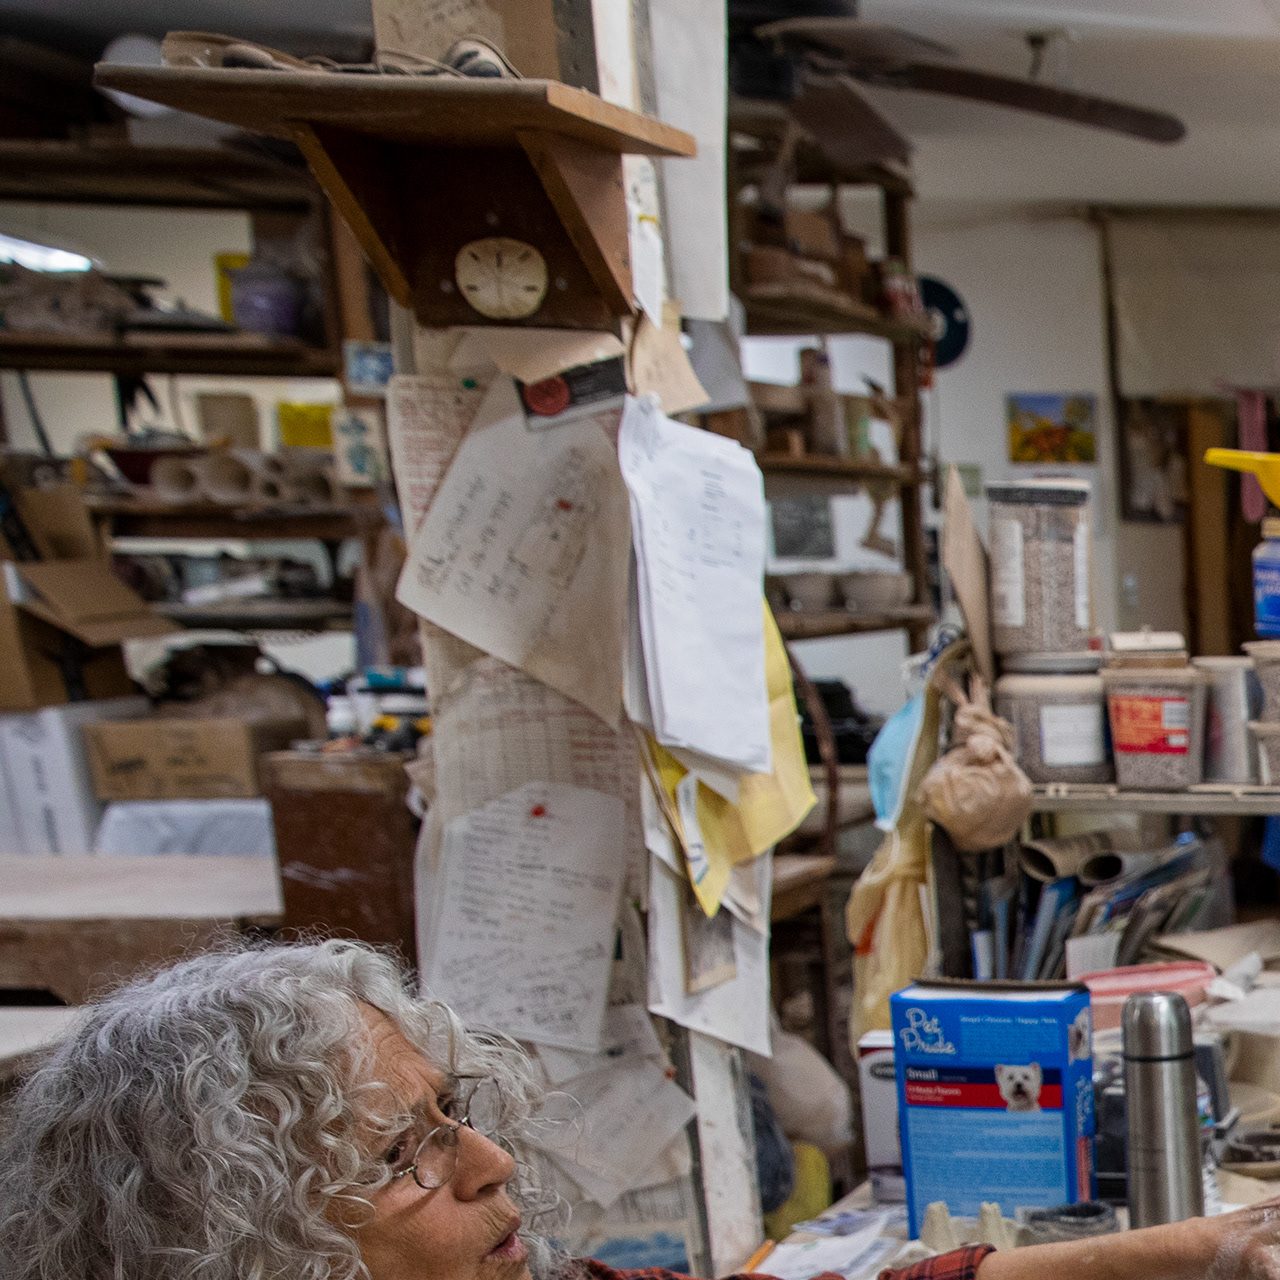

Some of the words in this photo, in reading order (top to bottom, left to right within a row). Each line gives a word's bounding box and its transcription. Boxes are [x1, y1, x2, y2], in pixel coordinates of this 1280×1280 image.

[905, 1007, 941, 1033] Pet
[899, 1027, 957, 1055] Pride
[905, 1068, 938, 1082] Small
